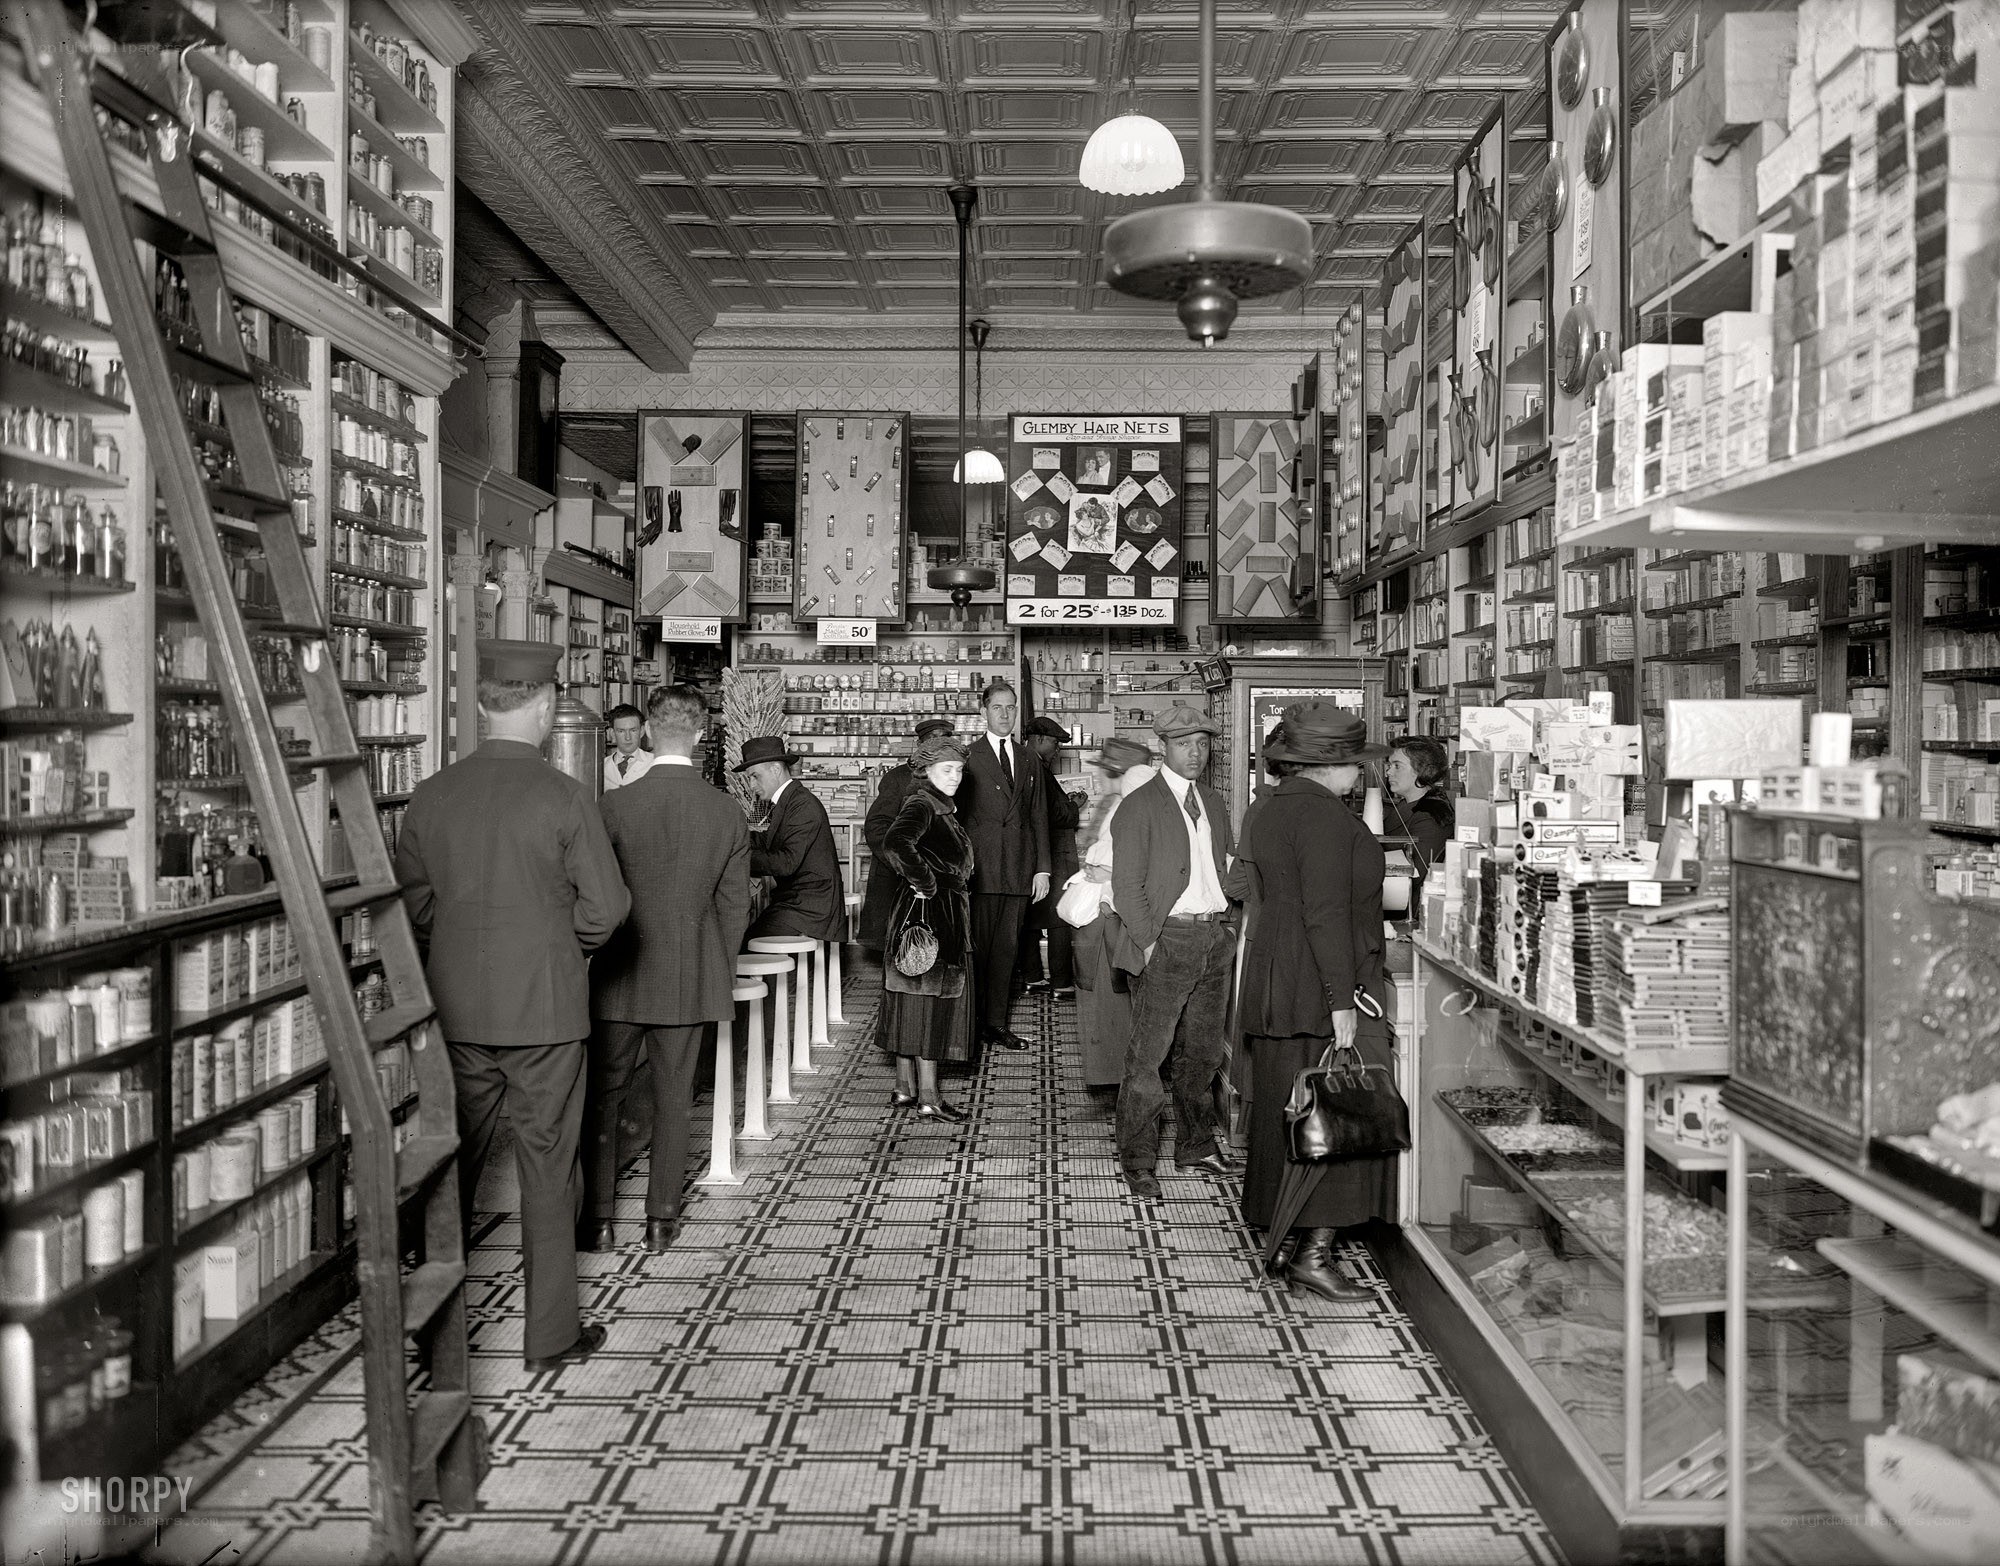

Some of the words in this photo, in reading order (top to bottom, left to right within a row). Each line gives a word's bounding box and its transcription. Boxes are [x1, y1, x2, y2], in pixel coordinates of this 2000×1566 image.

[1022, 421, 1078, 434] GLEMBY
[1084, 421, 1119, 434] HAIR
[1124, 421, 1170, 434] NETS
[1018, 604, 1036, 618] 2
[1041, 605, 1060, 618] for
